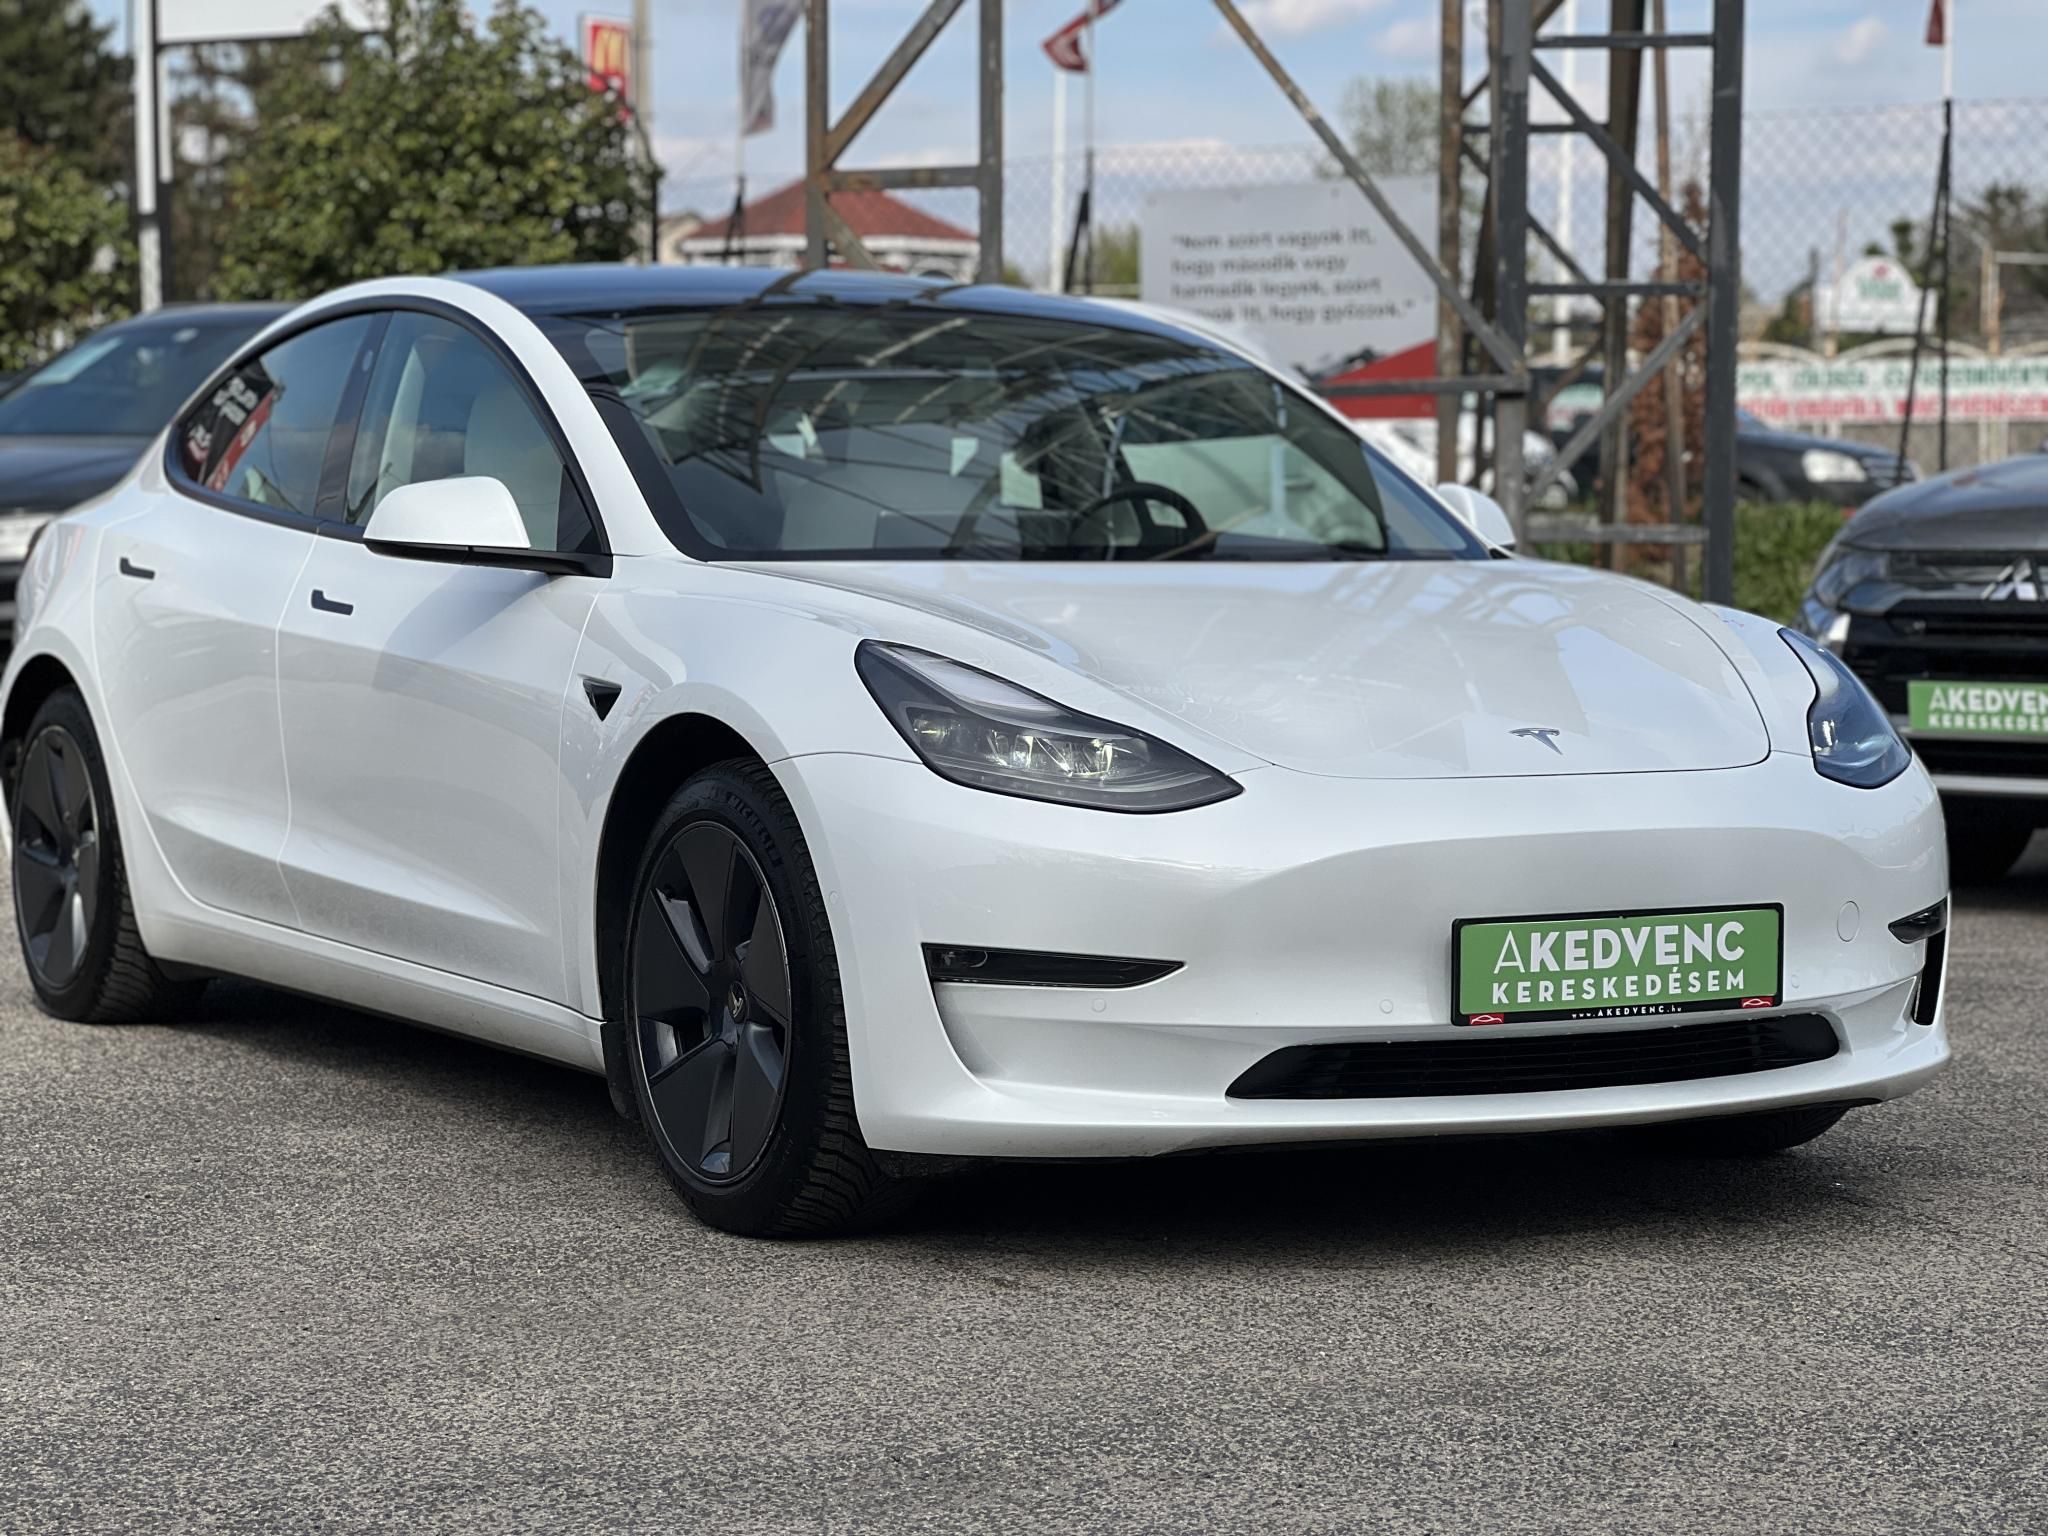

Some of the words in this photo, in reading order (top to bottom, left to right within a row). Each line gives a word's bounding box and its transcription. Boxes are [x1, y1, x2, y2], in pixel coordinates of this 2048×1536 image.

[1493, 921, 1745, 974] AKEDVENC
[1492, 967, 1744, 1005] KERESKEDÉSEM
[1571, 1004, 1682, 1019] www.AKEDVENC.hu
